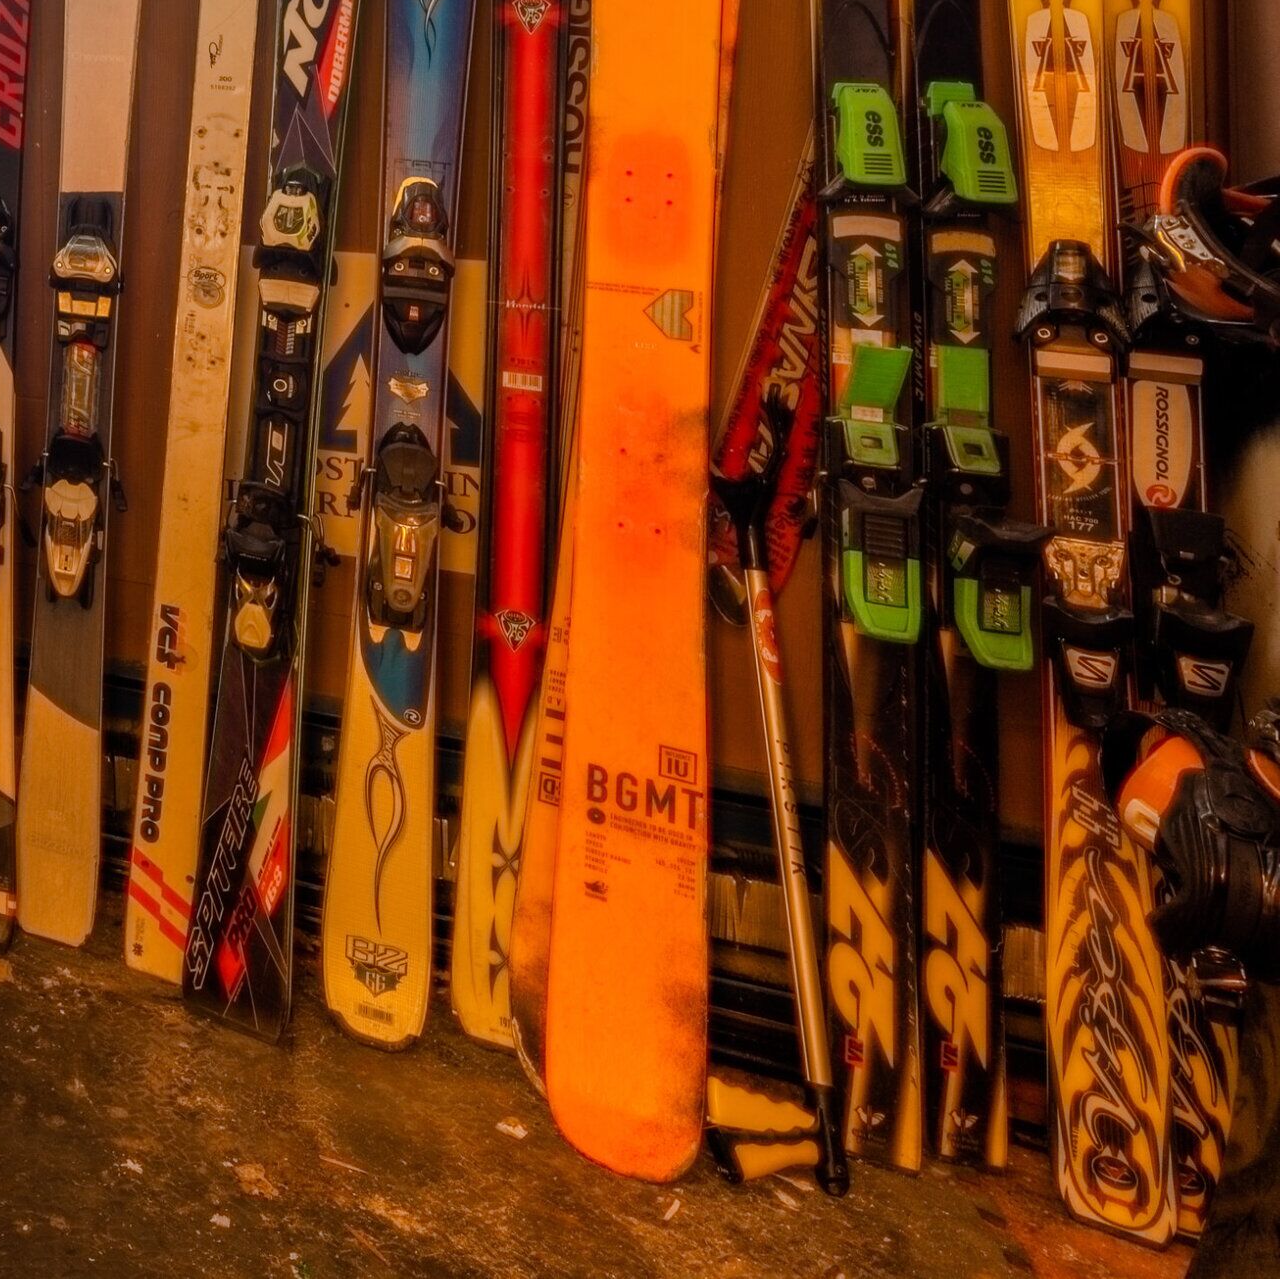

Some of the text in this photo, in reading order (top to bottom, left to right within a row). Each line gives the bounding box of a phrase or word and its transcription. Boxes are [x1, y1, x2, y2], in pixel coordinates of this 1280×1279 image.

[865, 110, 885, 148] ess
[976, 126, 997, 165] ess
[193, 269, 219, 281] Sport
[1155, 385, 1170, 482] ROSSIGNOL
[147, 681, 173, 774] COMP
[586, 762, 704, 830] BGMT
[666, 756, 689, 778] IU
[140, 773, 166, 844] PRO
[775, 738, 807, 878] PIKSTIK
[186, 758, 261, 990] SPITFIRE
[264, 864, 283, 914] 168
[225, 884, 259, 961] PRO
[1080, 847, 1148, 1151] Viper
